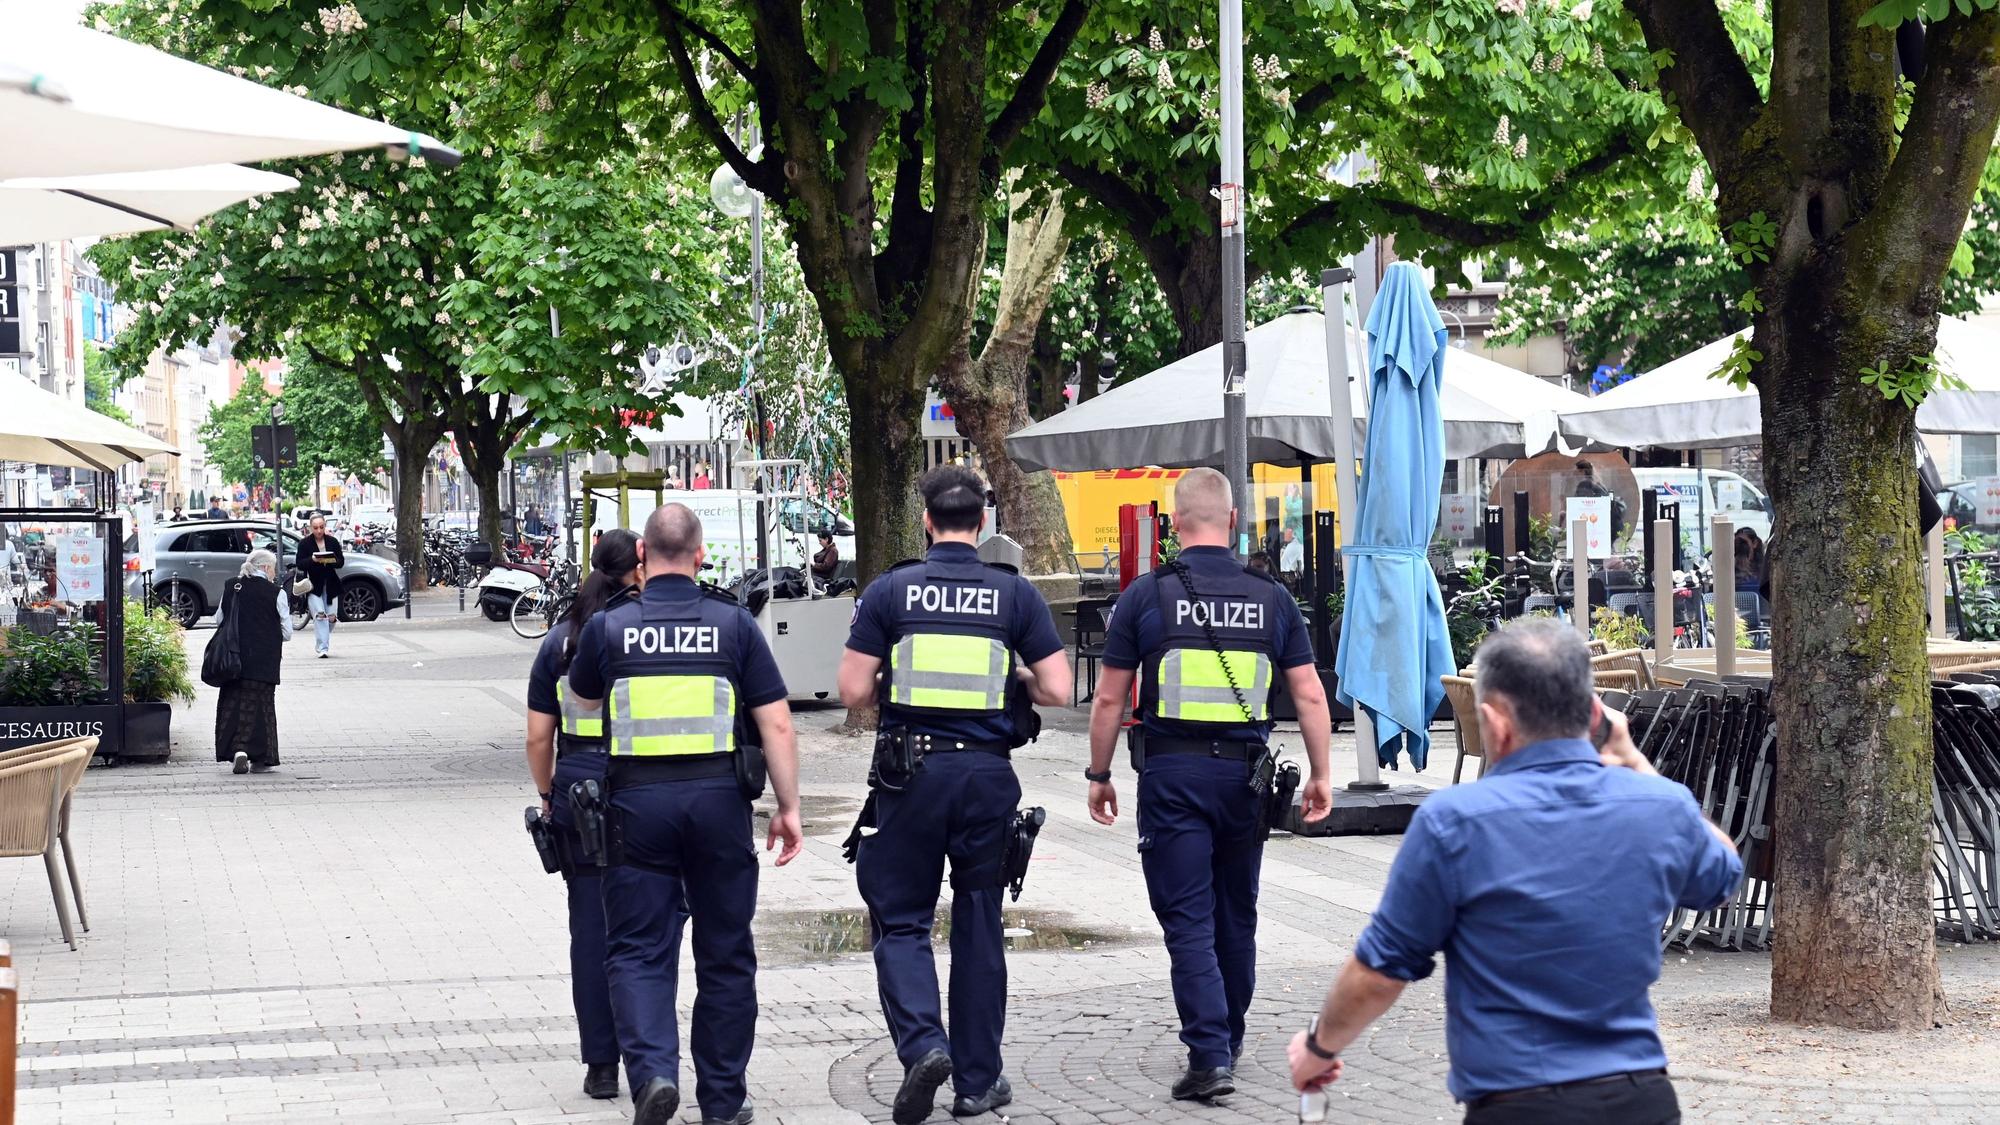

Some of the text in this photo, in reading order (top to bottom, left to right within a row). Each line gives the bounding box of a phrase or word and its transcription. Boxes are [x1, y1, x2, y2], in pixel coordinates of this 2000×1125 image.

[906, 584, 999, 615] POLIZEI
[1176, 599, 1264, 629] POLIZEI
[623, 626, 719, 654] POLIZEI
